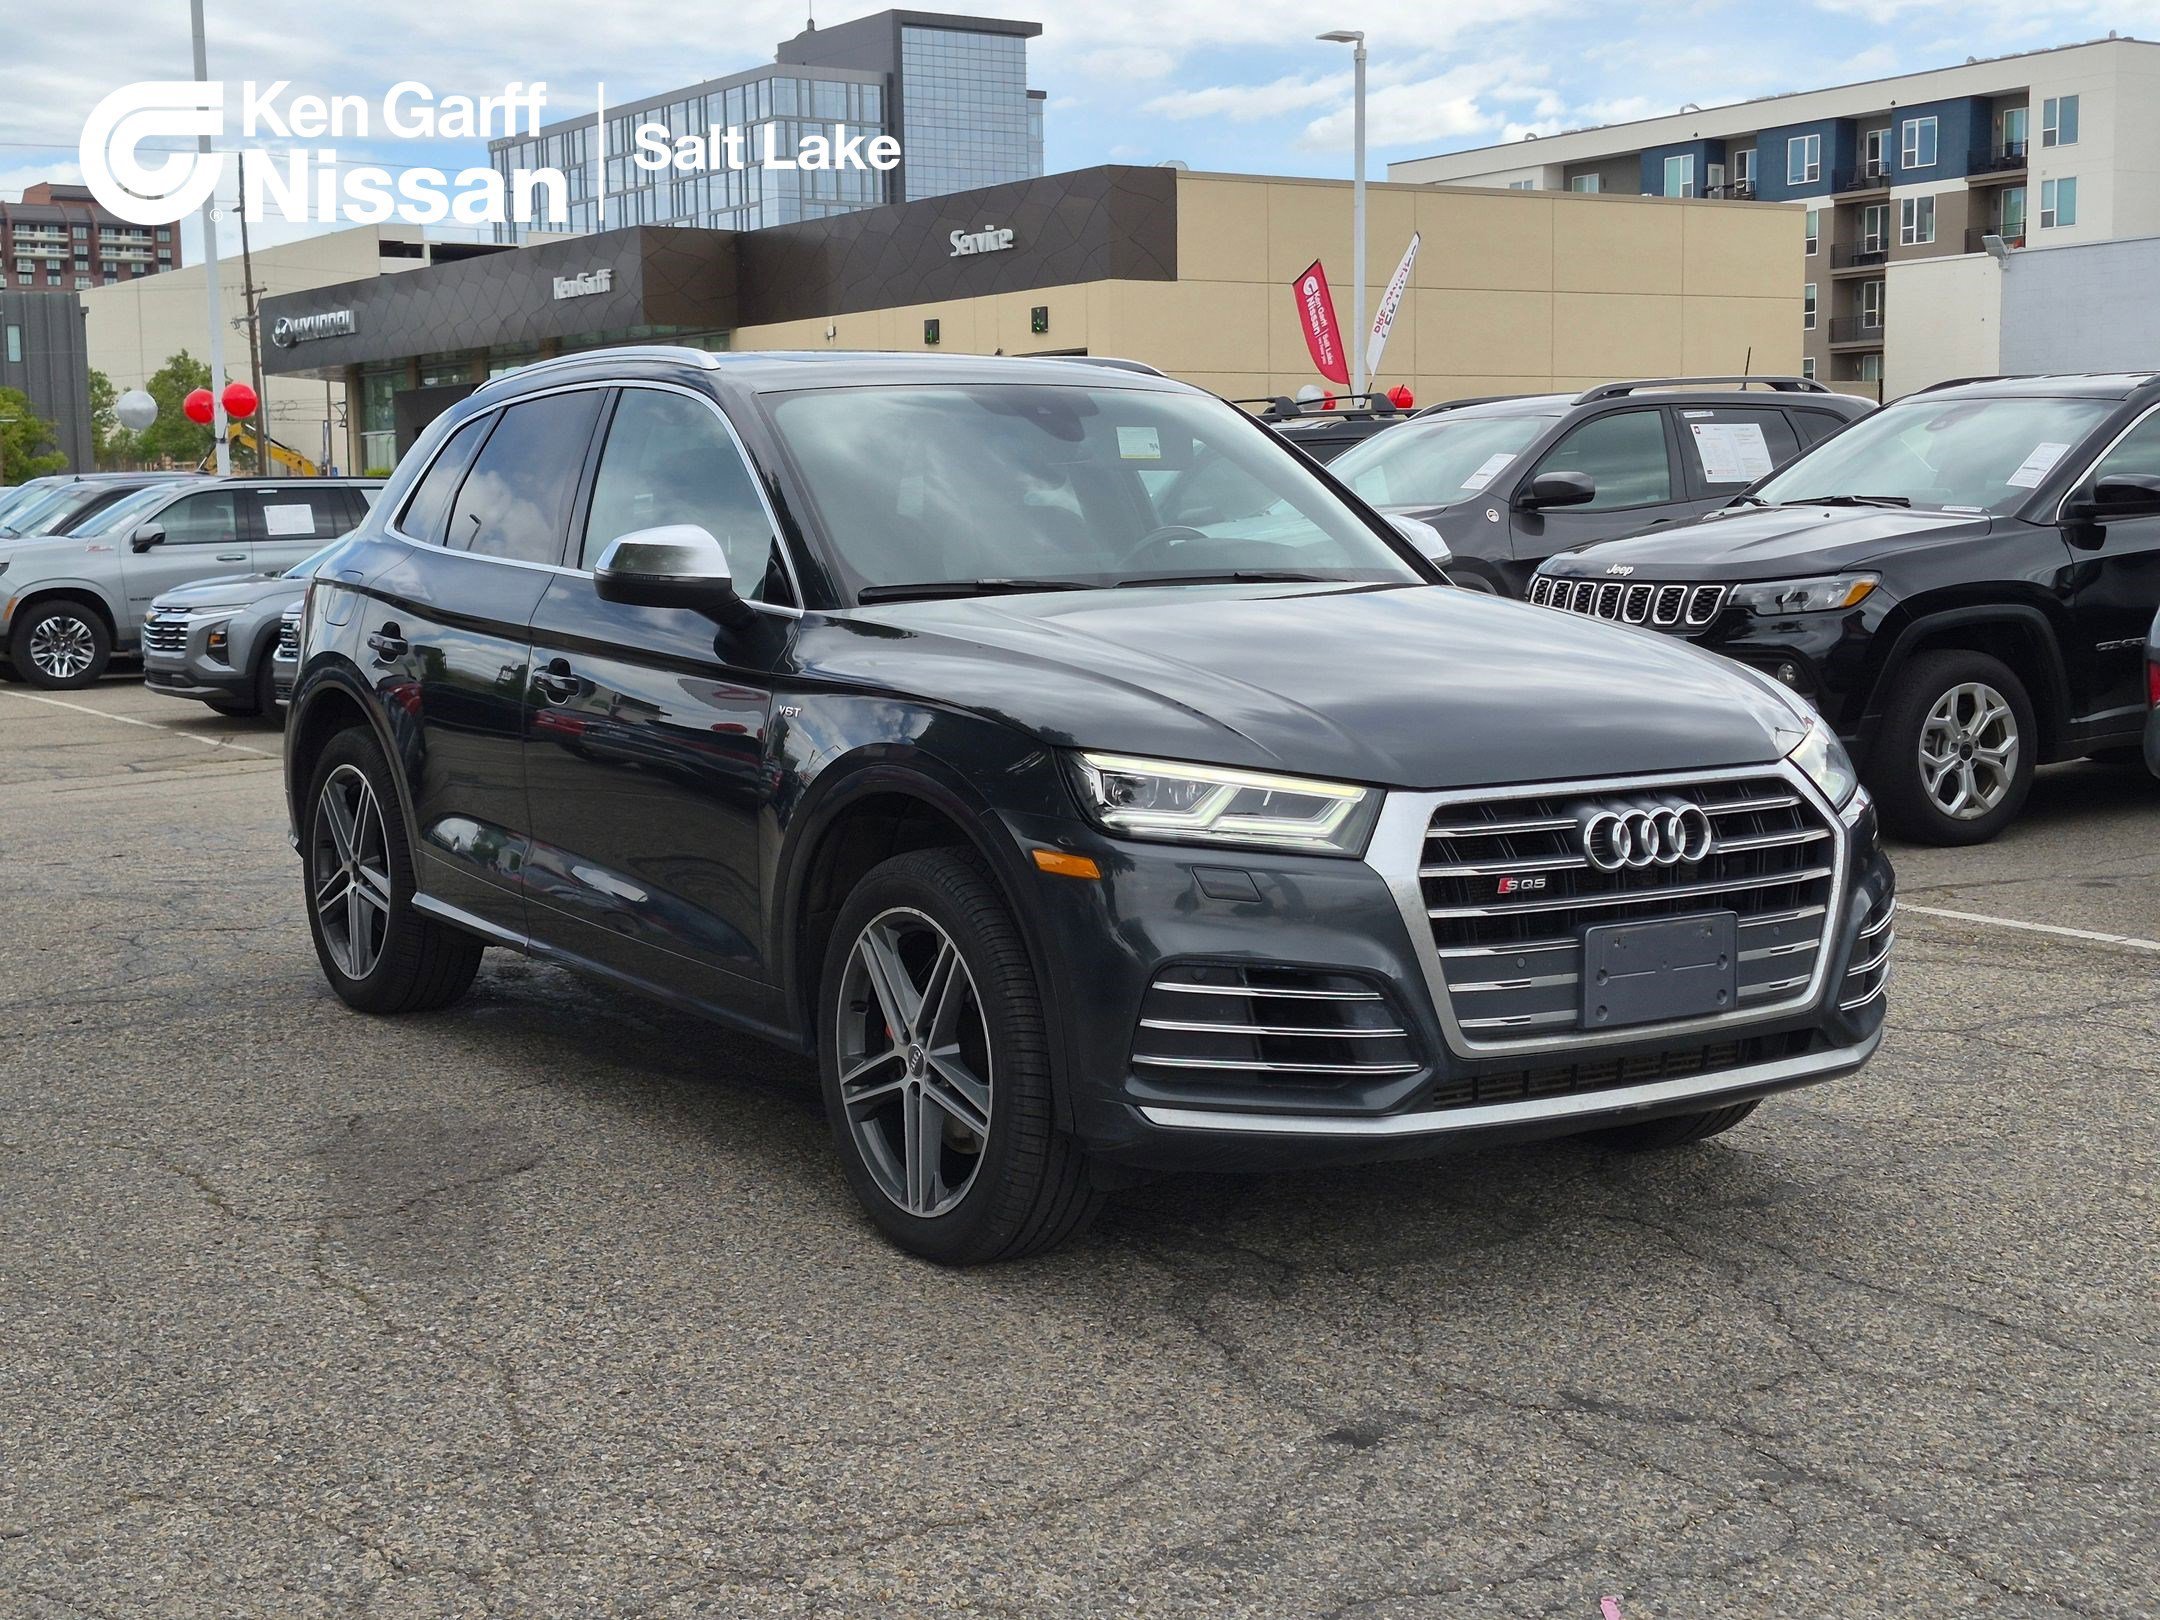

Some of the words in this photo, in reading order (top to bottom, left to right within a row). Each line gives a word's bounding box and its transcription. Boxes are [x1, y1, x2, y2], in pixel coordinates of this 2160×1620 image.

[949, 224, 1014, 257] Service
[1306, 296, 1320, 336] Nissan
[1606, 563, 1634, 577] Jeep
[779, 704, 802, 718] V6T
